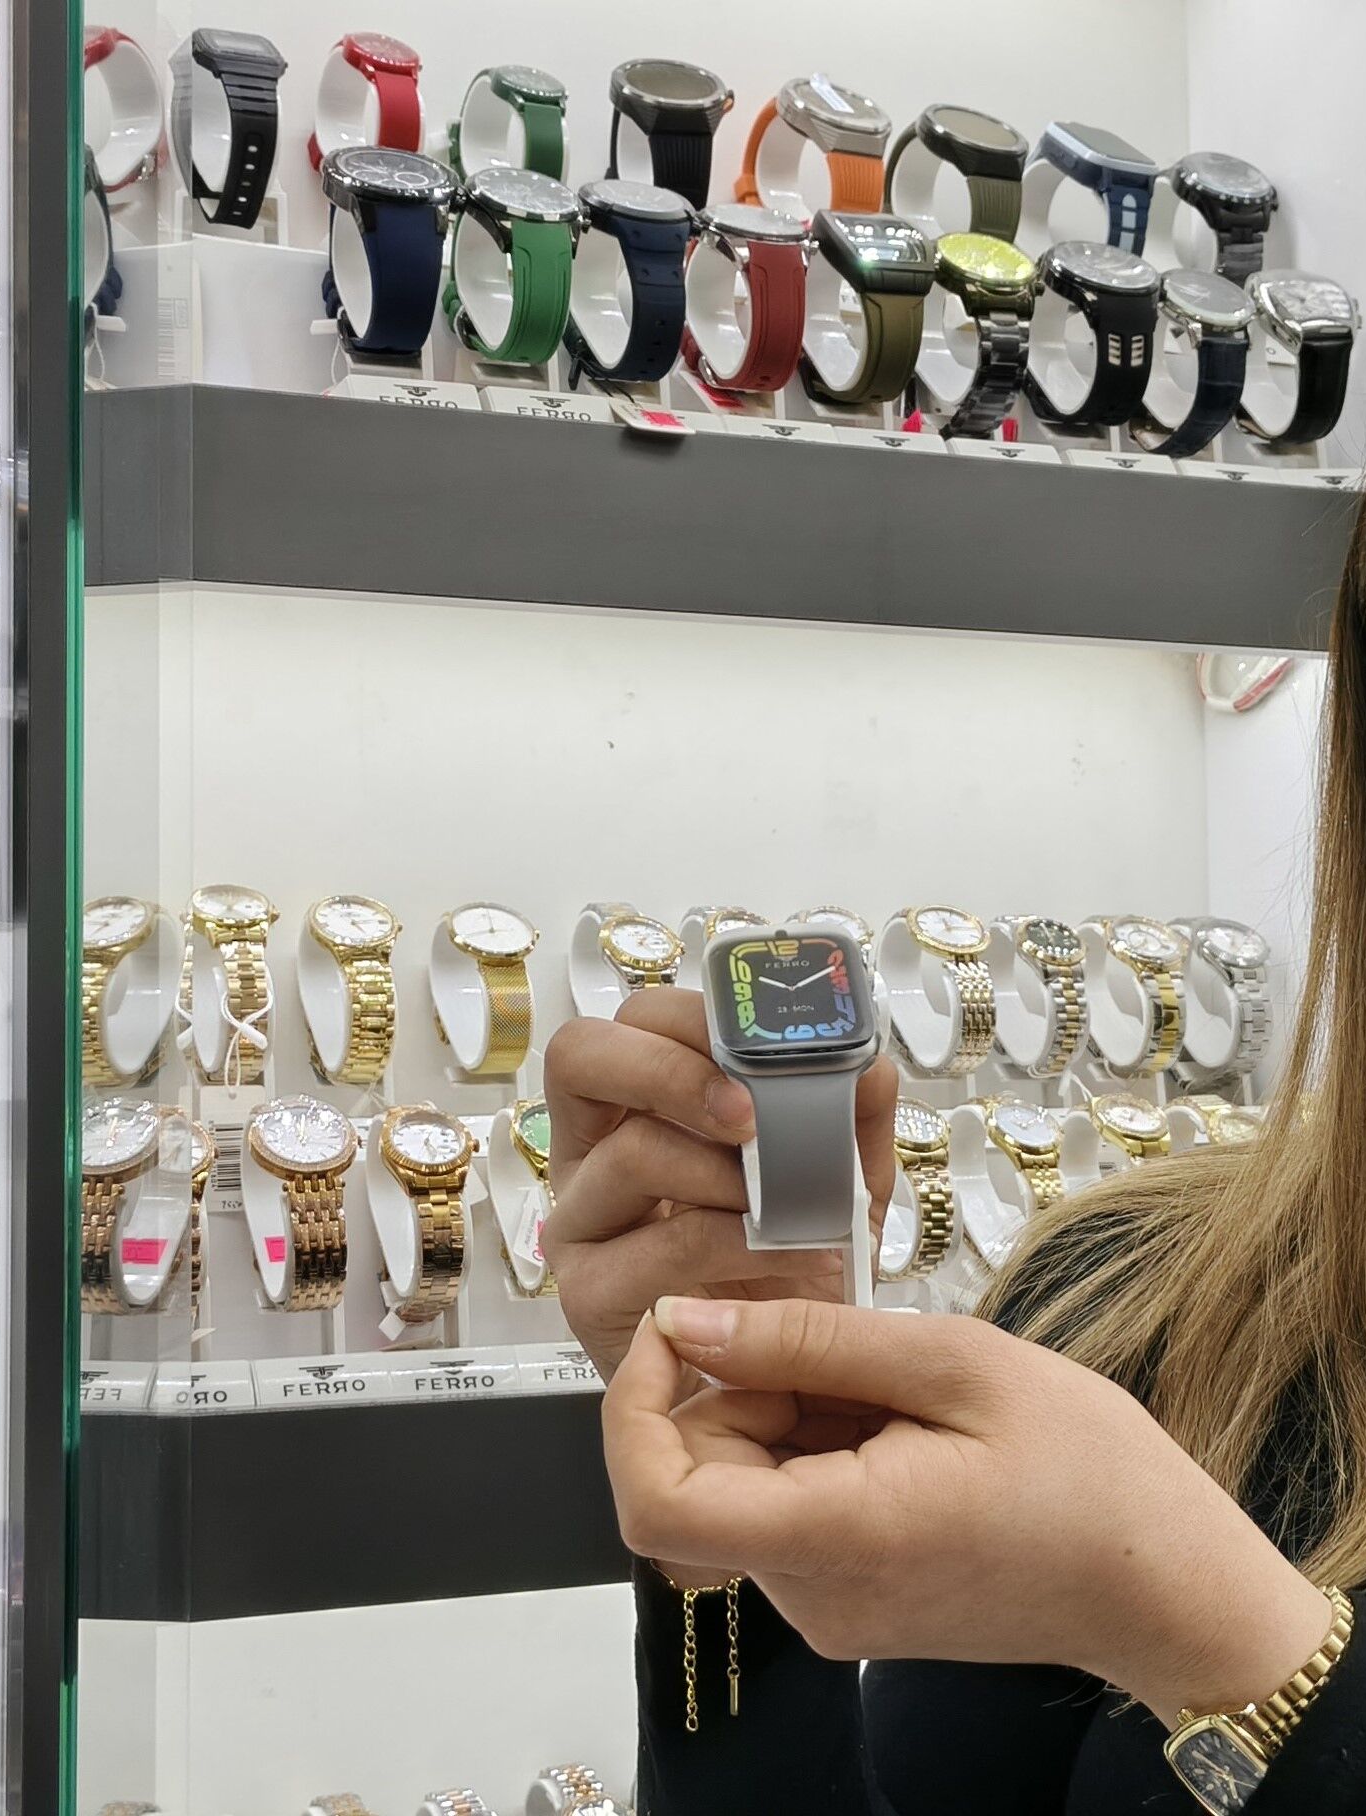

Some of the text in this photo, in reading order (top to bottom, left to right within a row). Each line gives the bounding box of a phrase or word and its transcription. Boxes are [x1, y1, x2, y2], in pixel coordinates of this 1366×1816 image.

[543, 1367, 598, 1381] FER
[283, 1379, 367, 1398] FERRO
[414, 1375, 495, 1392] FERRO
